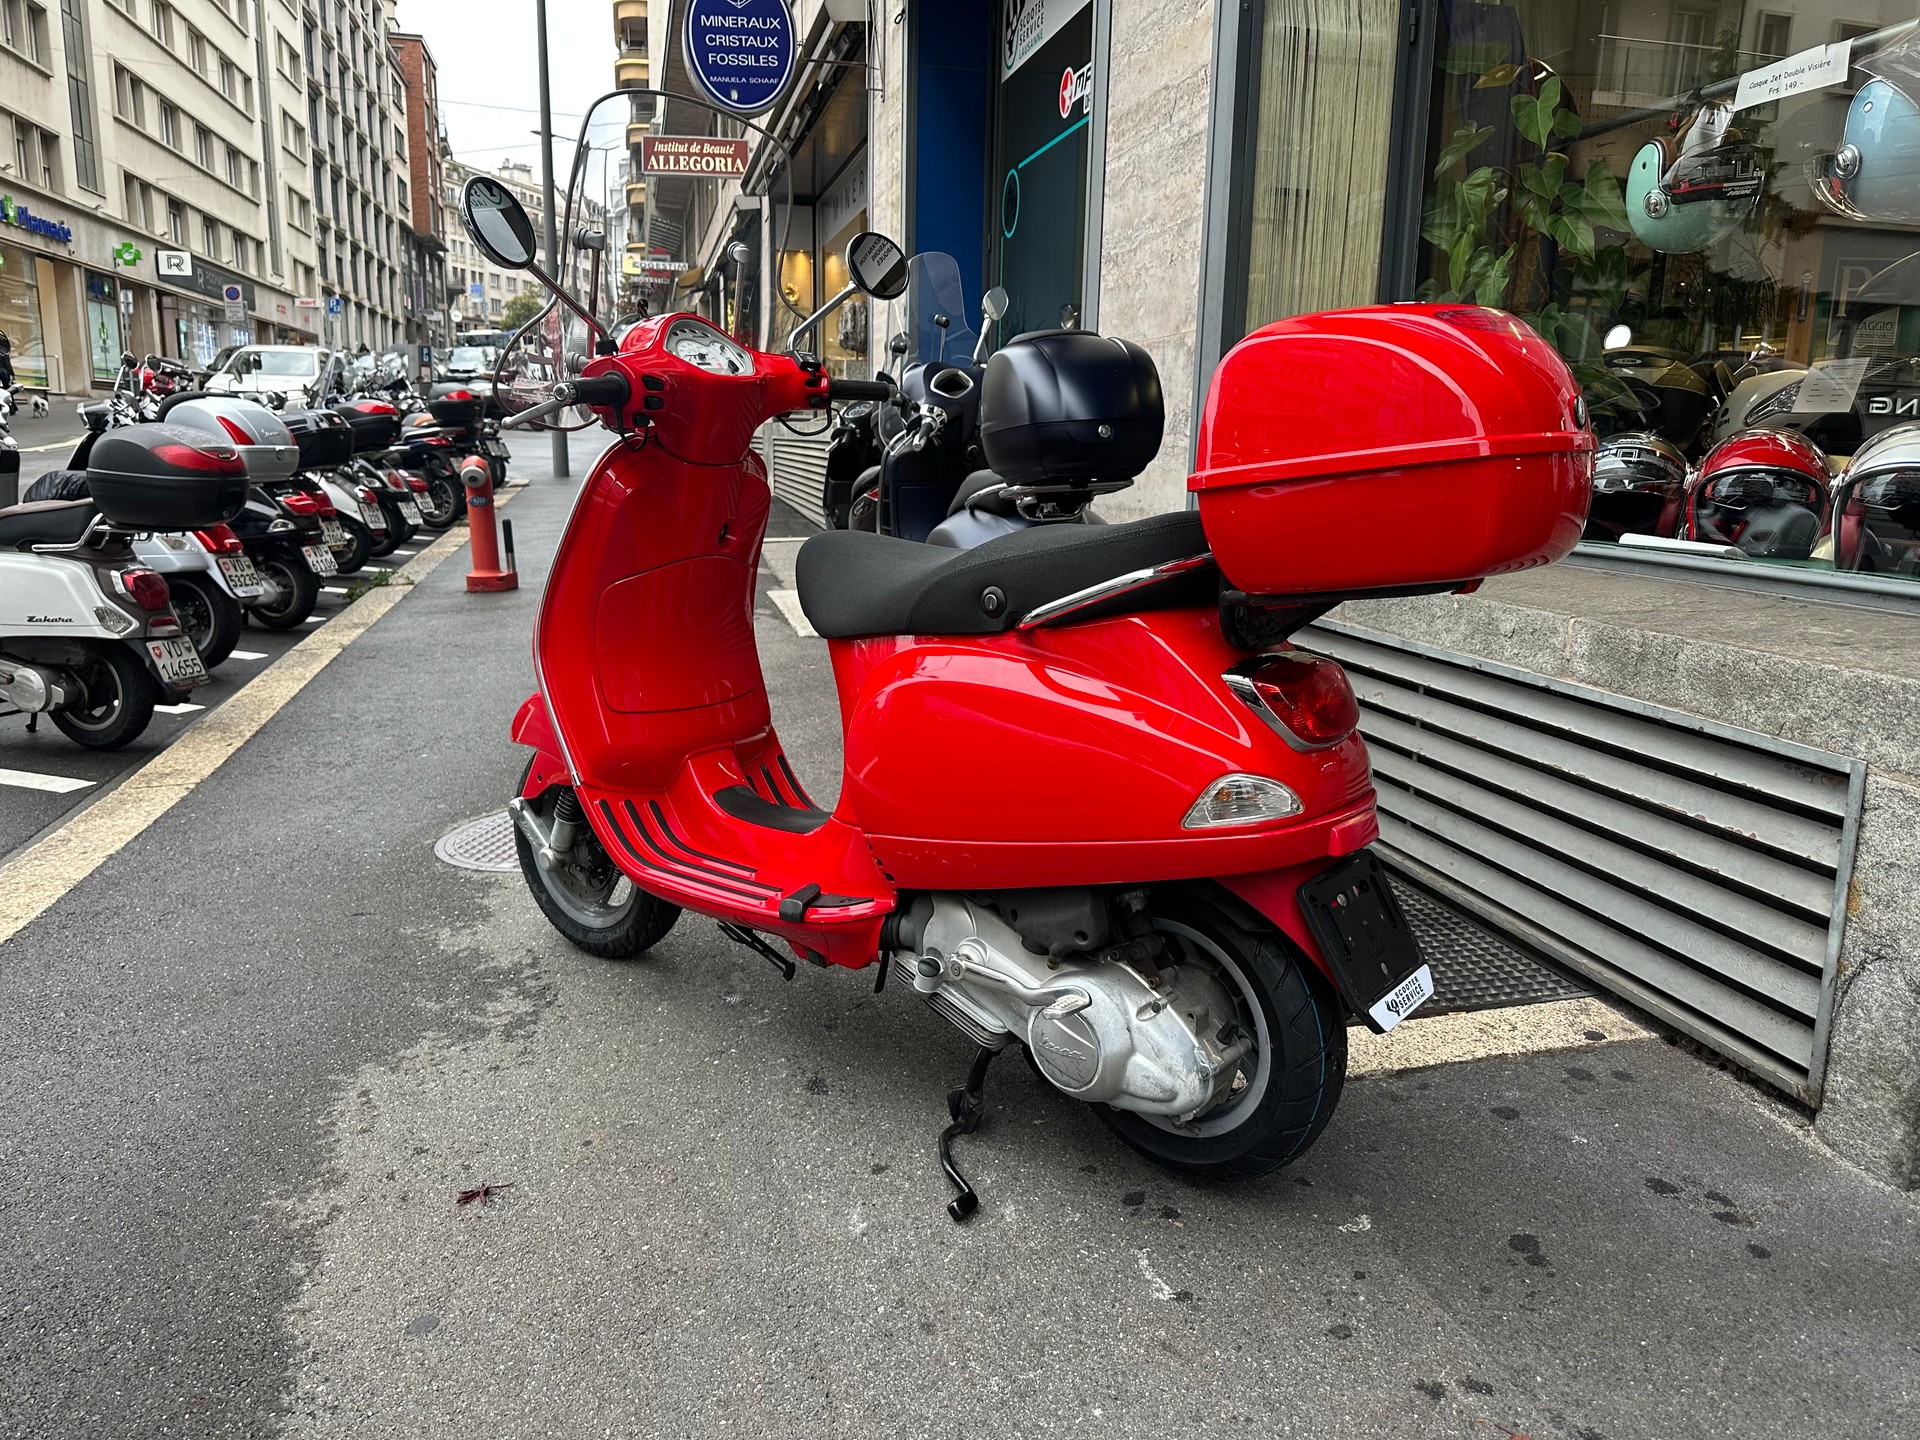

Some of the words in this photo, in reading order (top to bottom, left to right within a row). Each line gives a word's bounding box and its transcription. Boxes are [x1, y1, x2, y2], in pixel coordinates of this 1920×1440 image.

[700, 14, 781, 30] MINERAUX
[1020, 0, 1044, 31] SCOOTER
[1019, 12, 1044, 46] SERVICE
[705, 34, 779, 48] CRISTAUX
[1019, 29, 1043, 59] LAUSANNE
[708, 53, 778, 67] FOSSILES
[710, 76, 747, 84] MANUELA
[1749, 79, 1768, 90] Casque
[1770, 74, 1781, 83] Jet
[1784, 67, 1805, 79] Double
[1807, 60, 1831, 72] Visière
[1768, 87, 1779, 95] Frs
[654, 141, 688, 154] Institut
[690, 142, 701, 154] de
[703, 142, 735, 155] Beauté
[647, 155, 745, 173] ALLEGORIA
[18, 206, 72, 242] Pharmacie
[166, 254, 184, 272] R
[310, 546, 324, 558] VD
[230, 559, 245, 572] VD
[312, 558, 337, 572] 61106
[228, 573, 260, 587] 53235
[162, 641, 183, 659] VD
[161, 657, 202, 680] 14655
[1394, 975, 1419, 999] SCOOTER
[1398, 983, 1424, 1009] SERVICE
